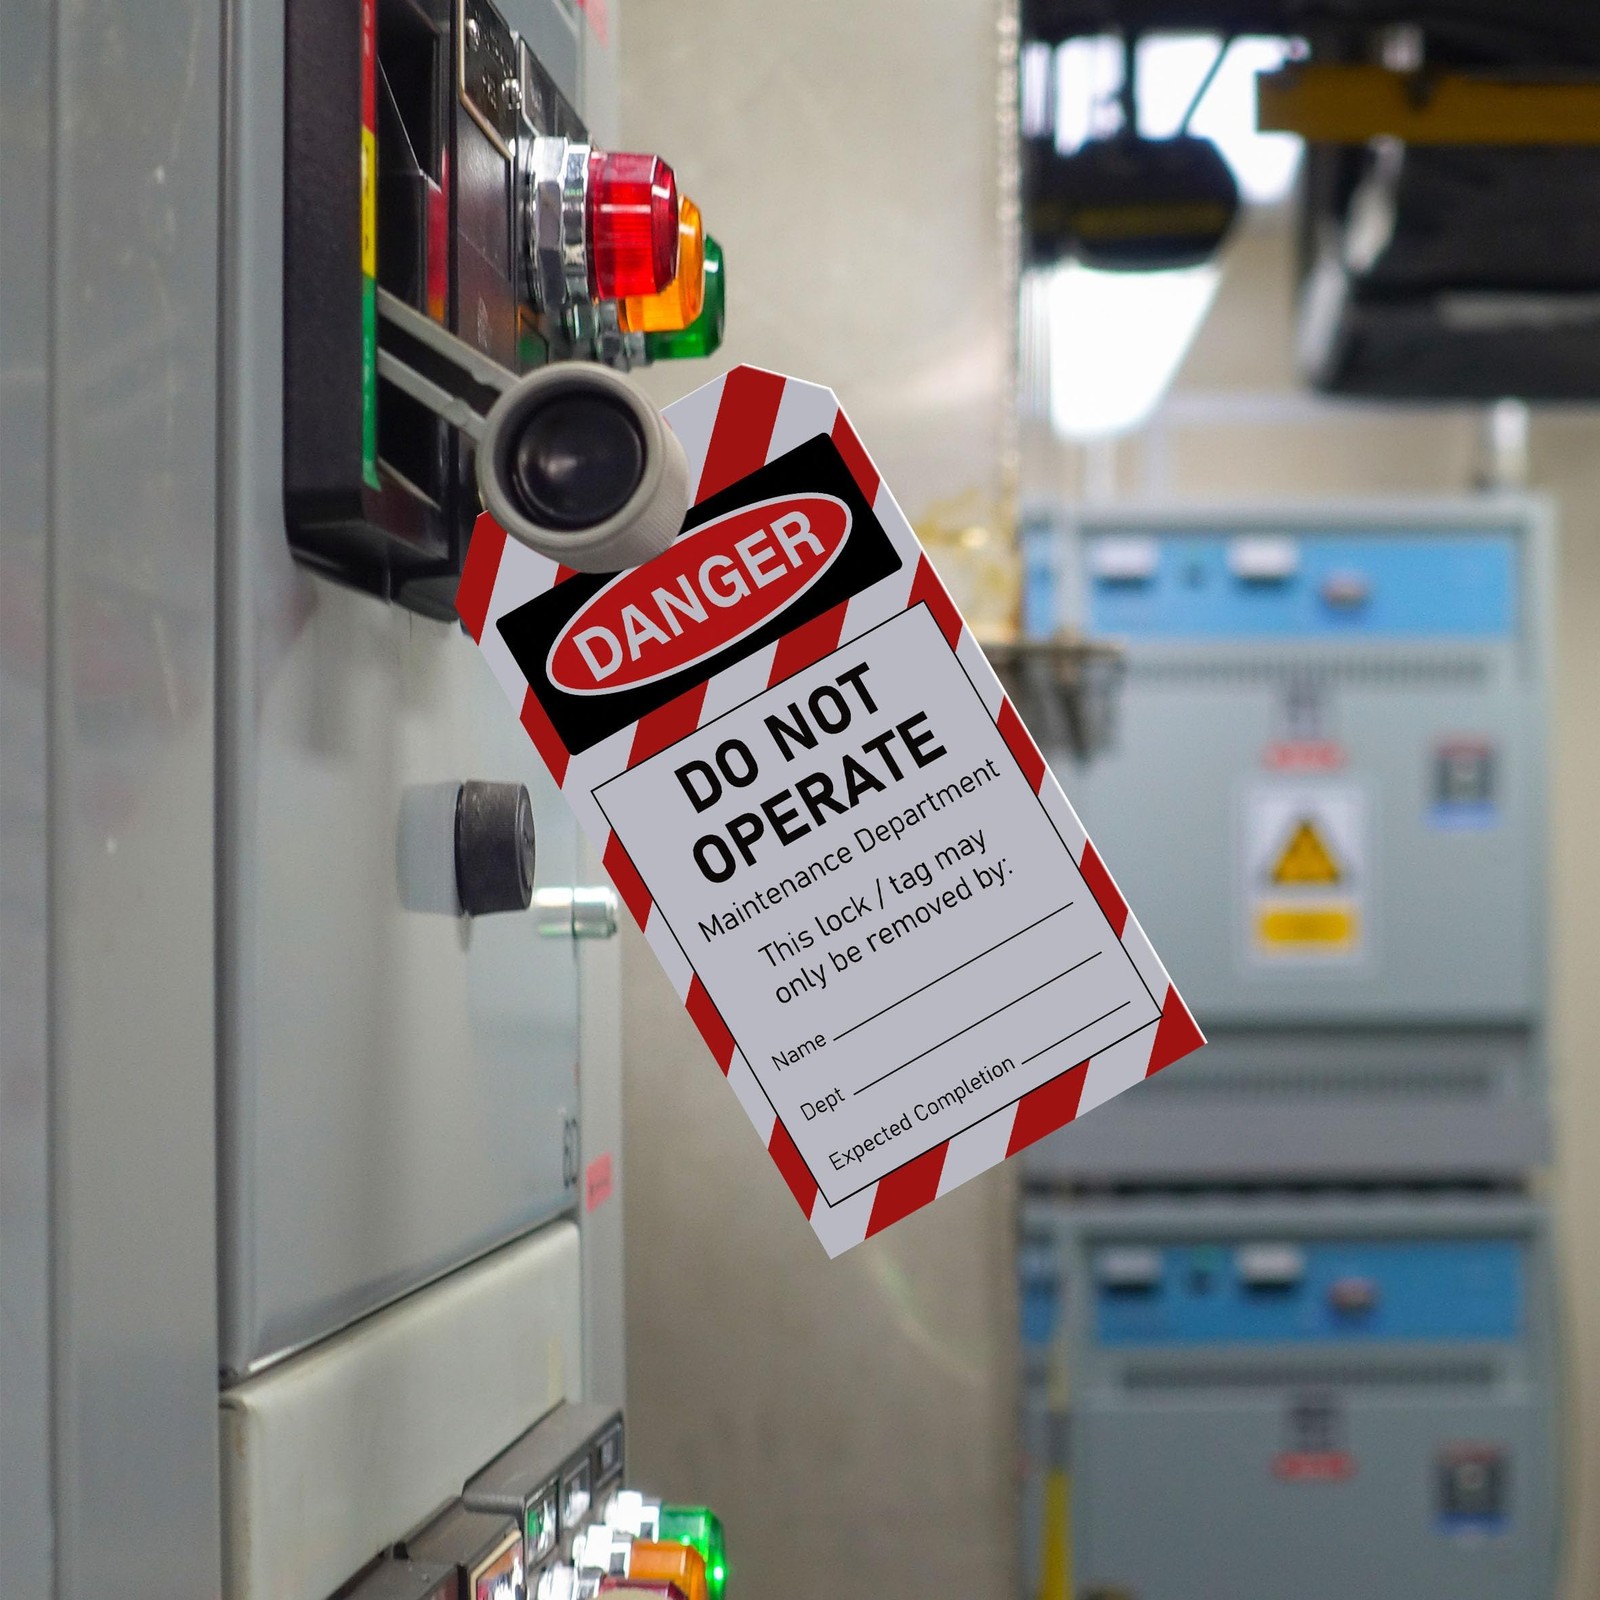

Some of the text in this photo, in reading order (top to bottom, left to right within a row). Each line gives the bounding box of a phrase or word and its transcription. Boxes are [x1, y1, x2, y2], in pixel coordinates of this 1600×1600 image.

[572, 511, 826, 682] DANGER
[674, 661, 879, 814] DO NOT
[692, 710, 948, 884] OPERATE
[697, 758, 1001, 943] Maintenance Department
[757, 829, 987, 967] This lock / tag may
[775, 858, 1013, 1004] only be removed by:
[771, 1034, 827, 1072] Name
[799, 1087, 846, 1122] Dept
[828, 1058, 1016, 1171] Expected Completion
